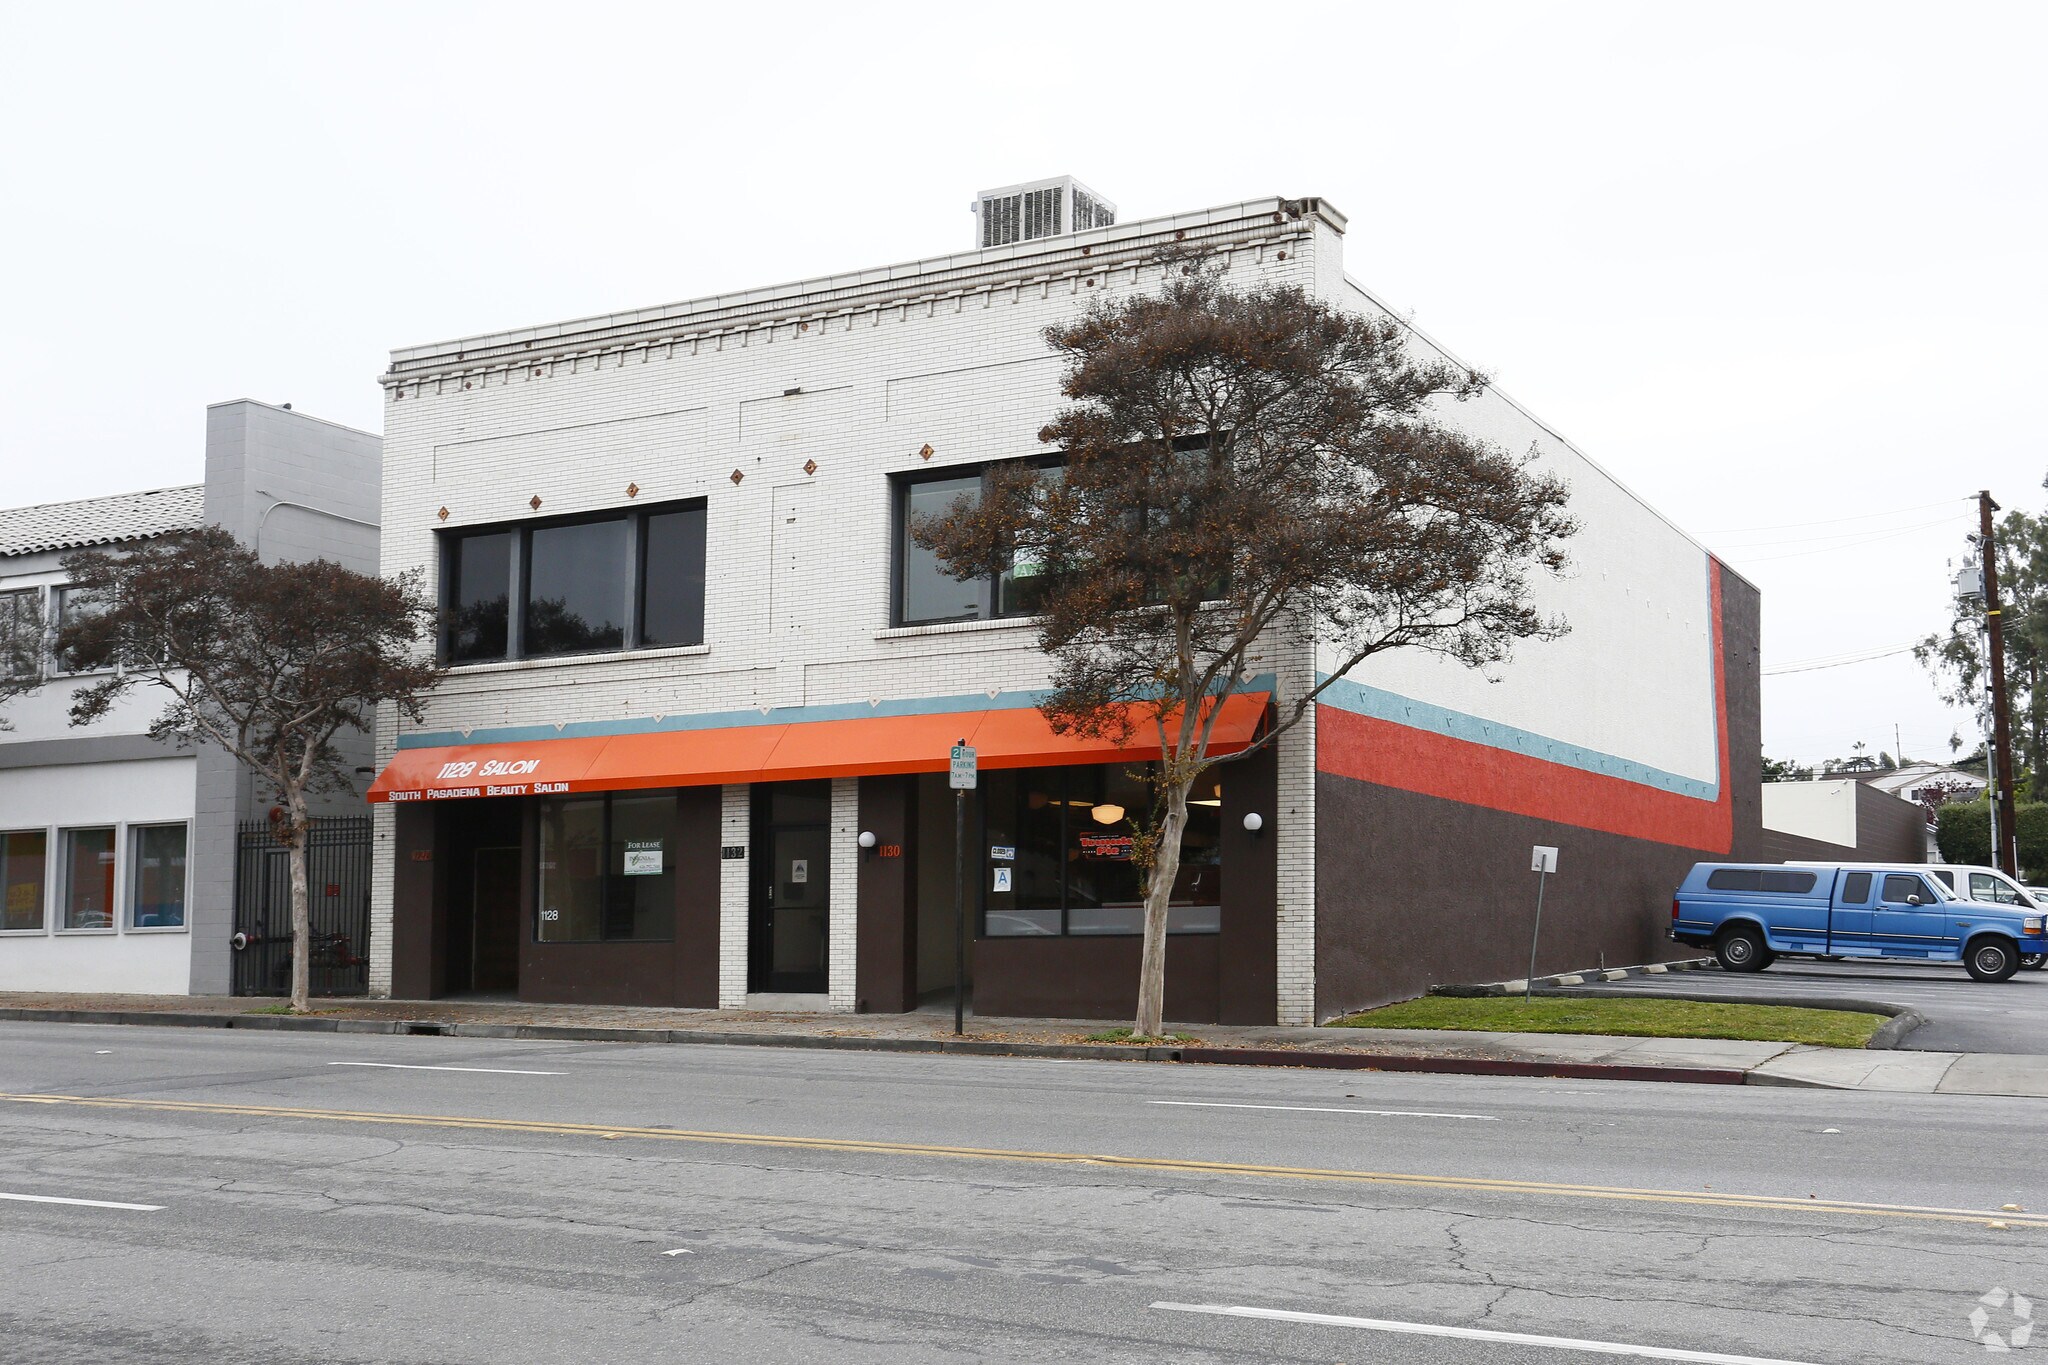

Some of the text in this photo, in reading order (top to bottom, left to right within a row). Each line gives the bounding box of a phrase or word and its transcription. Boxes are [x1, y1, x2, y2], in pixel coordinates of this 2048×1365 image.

[953, 748, 960, 758] 2
[436, 760, 541, 779] 1128 SALON
[953, 761, 975, 769] PARKING
[389, 783, 569, 801] SOUTH PASADENA BEAUTY SALON
[627, 841, 661, 849] FOR LEASE
[880, 845, 900, 857] 1130
[721, 846, 744, 859] 1132
[998, 871, 1008, 884] A
[541, 910, 559, 921] 1128
